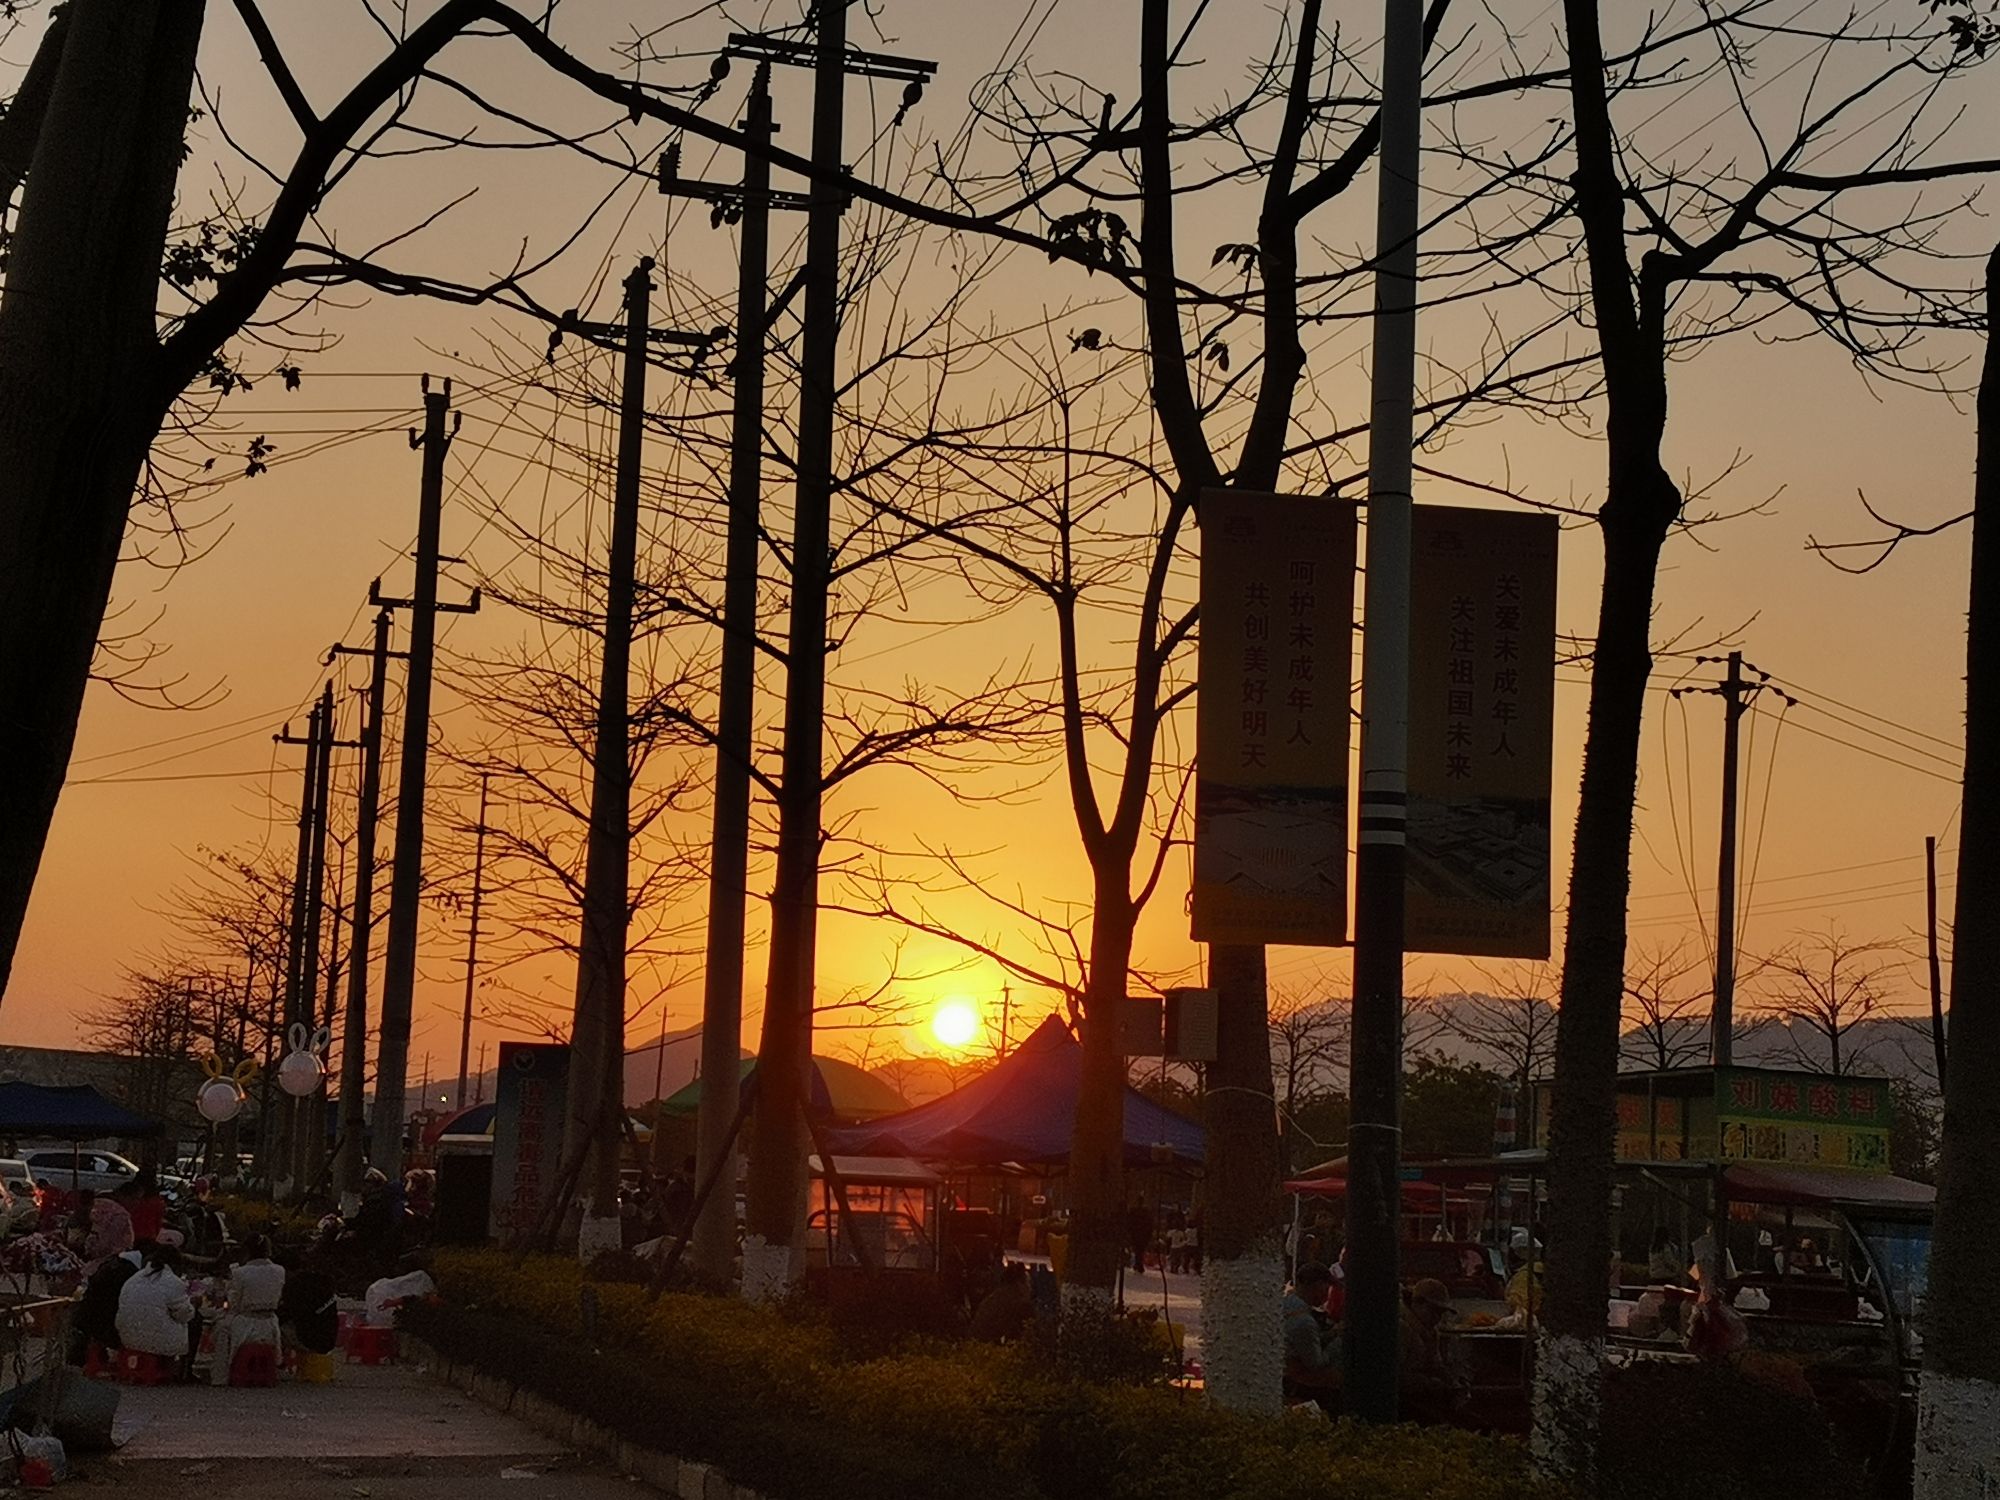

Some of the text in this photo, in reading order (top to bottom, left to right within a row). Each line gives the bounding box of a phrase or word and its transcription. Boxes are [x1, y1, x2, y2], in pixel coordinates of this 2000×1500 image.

[1241, 582, 1271, 769] 共创美好明天
[1287, 560, 1316, 746] 呵护未成年人
[1446, 596, 1476, 780] 关注祖国未来
[1491, 574, 1522, 758] 关爱未成年人
